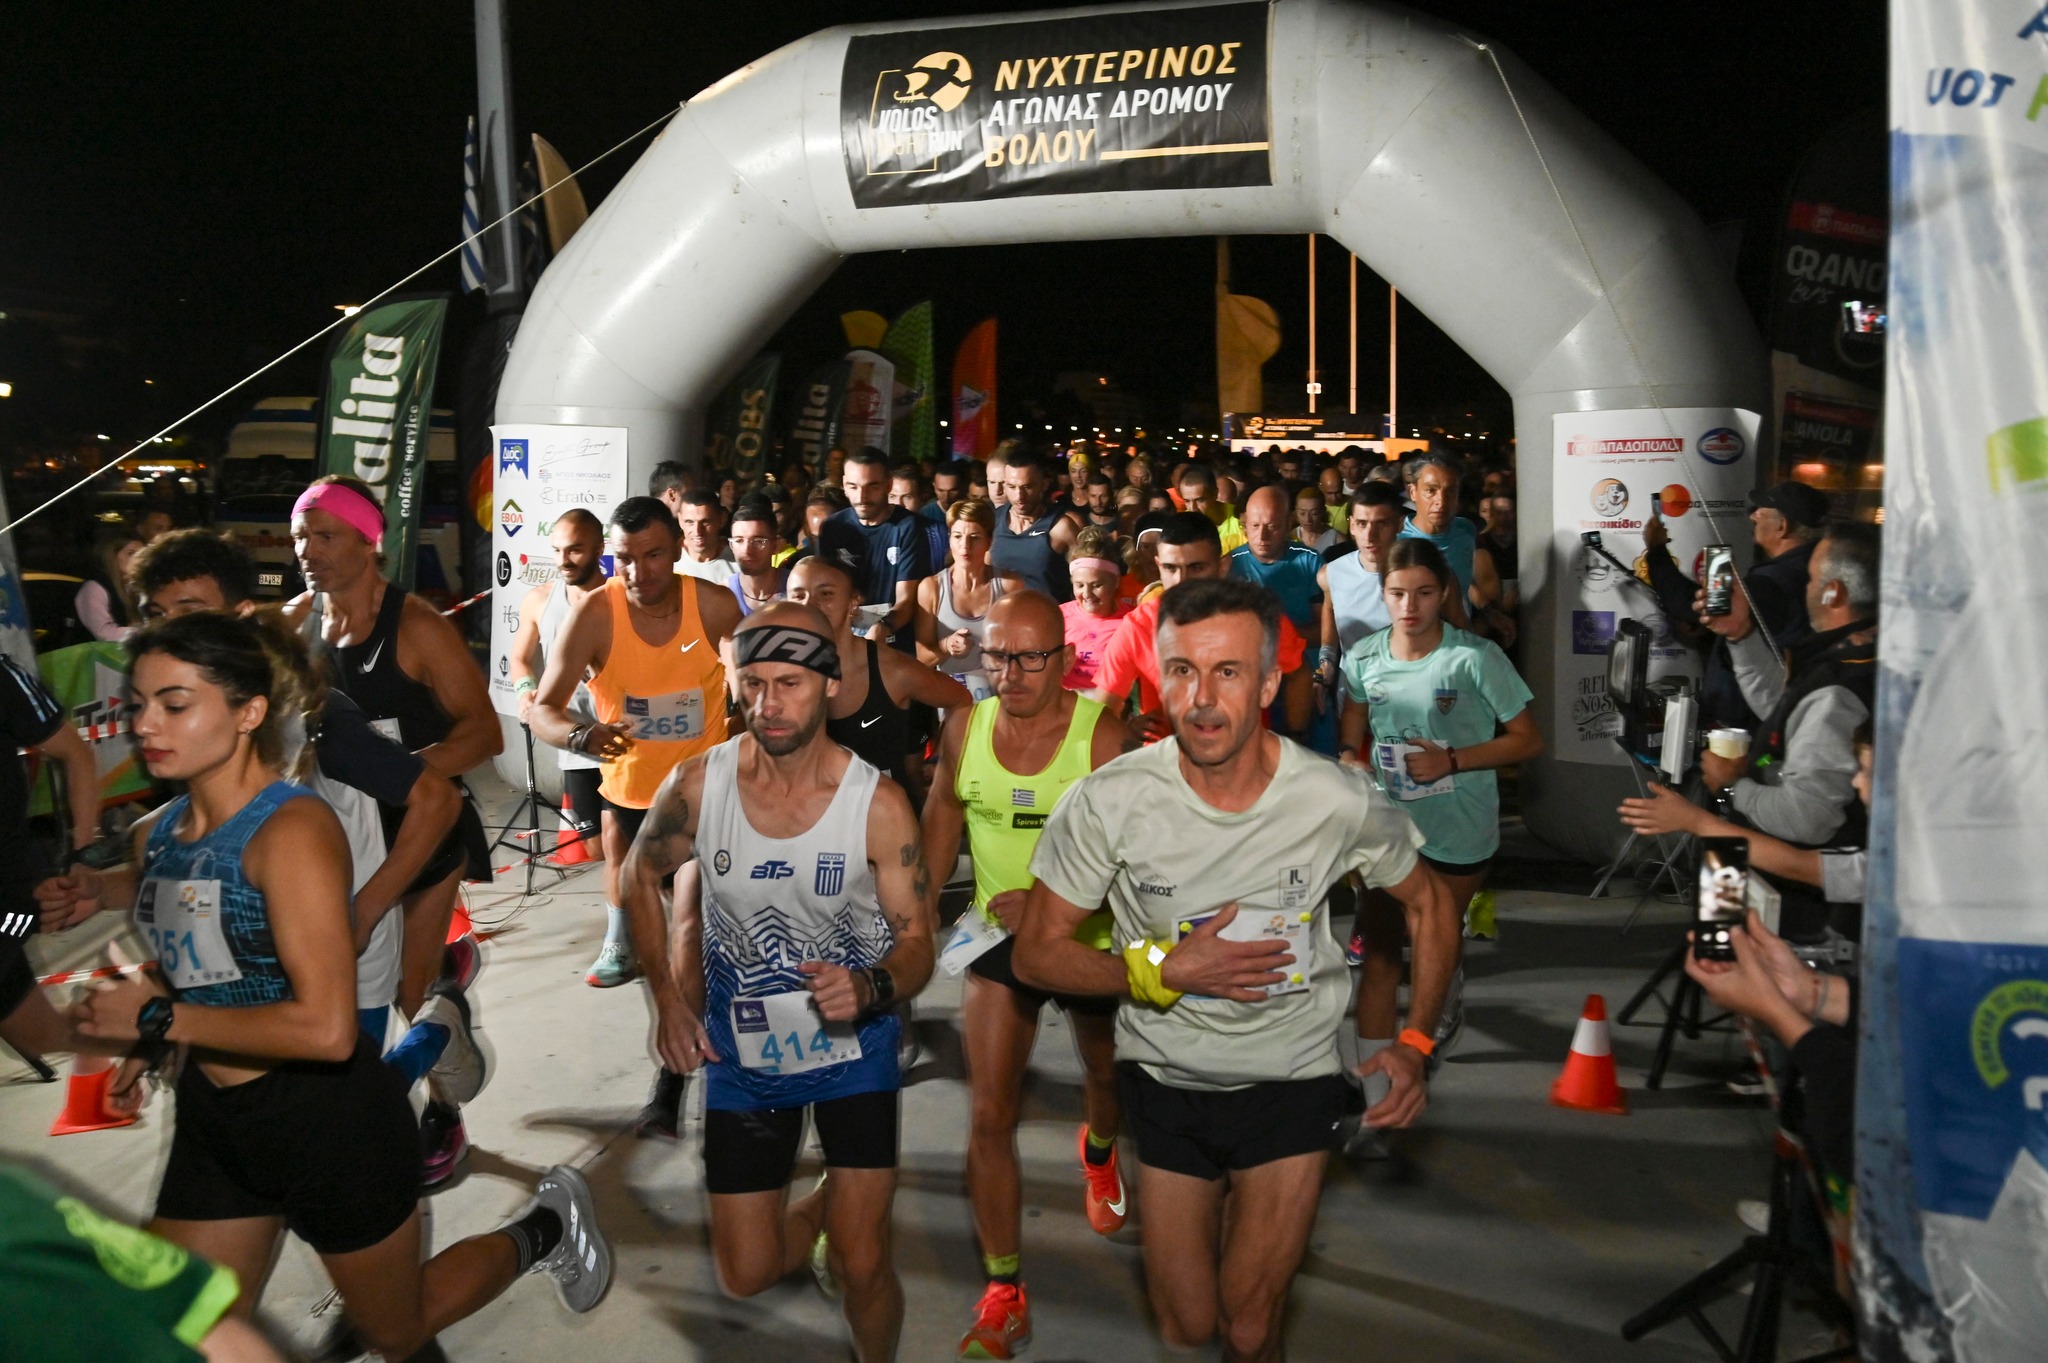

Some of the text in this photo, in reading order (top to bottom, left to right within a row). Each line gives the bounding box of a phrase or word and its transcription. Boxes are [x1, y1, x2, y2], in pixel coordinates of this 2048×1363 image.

[994, 41, 1243, 91] ΝΥΧΤΕΡΙΝΟΣ
[879, 106, 938, 132] VOLOS
[987, 82, 1233, 127] ΑΓΩΝΑΣ ΔΡΟΜΟΥ
[928, 130, 963, 153] RUN
[985, 128, 1096, 168] ΒΟΛΟΥ
[332, 333, 404, 505] alita
[397, 405, 419, 518] coffee service
[1707, 500, 1745, 508] SERVICE
[639, 714, 689, 736] 265
[761, 1028, 833, 1065] 414
